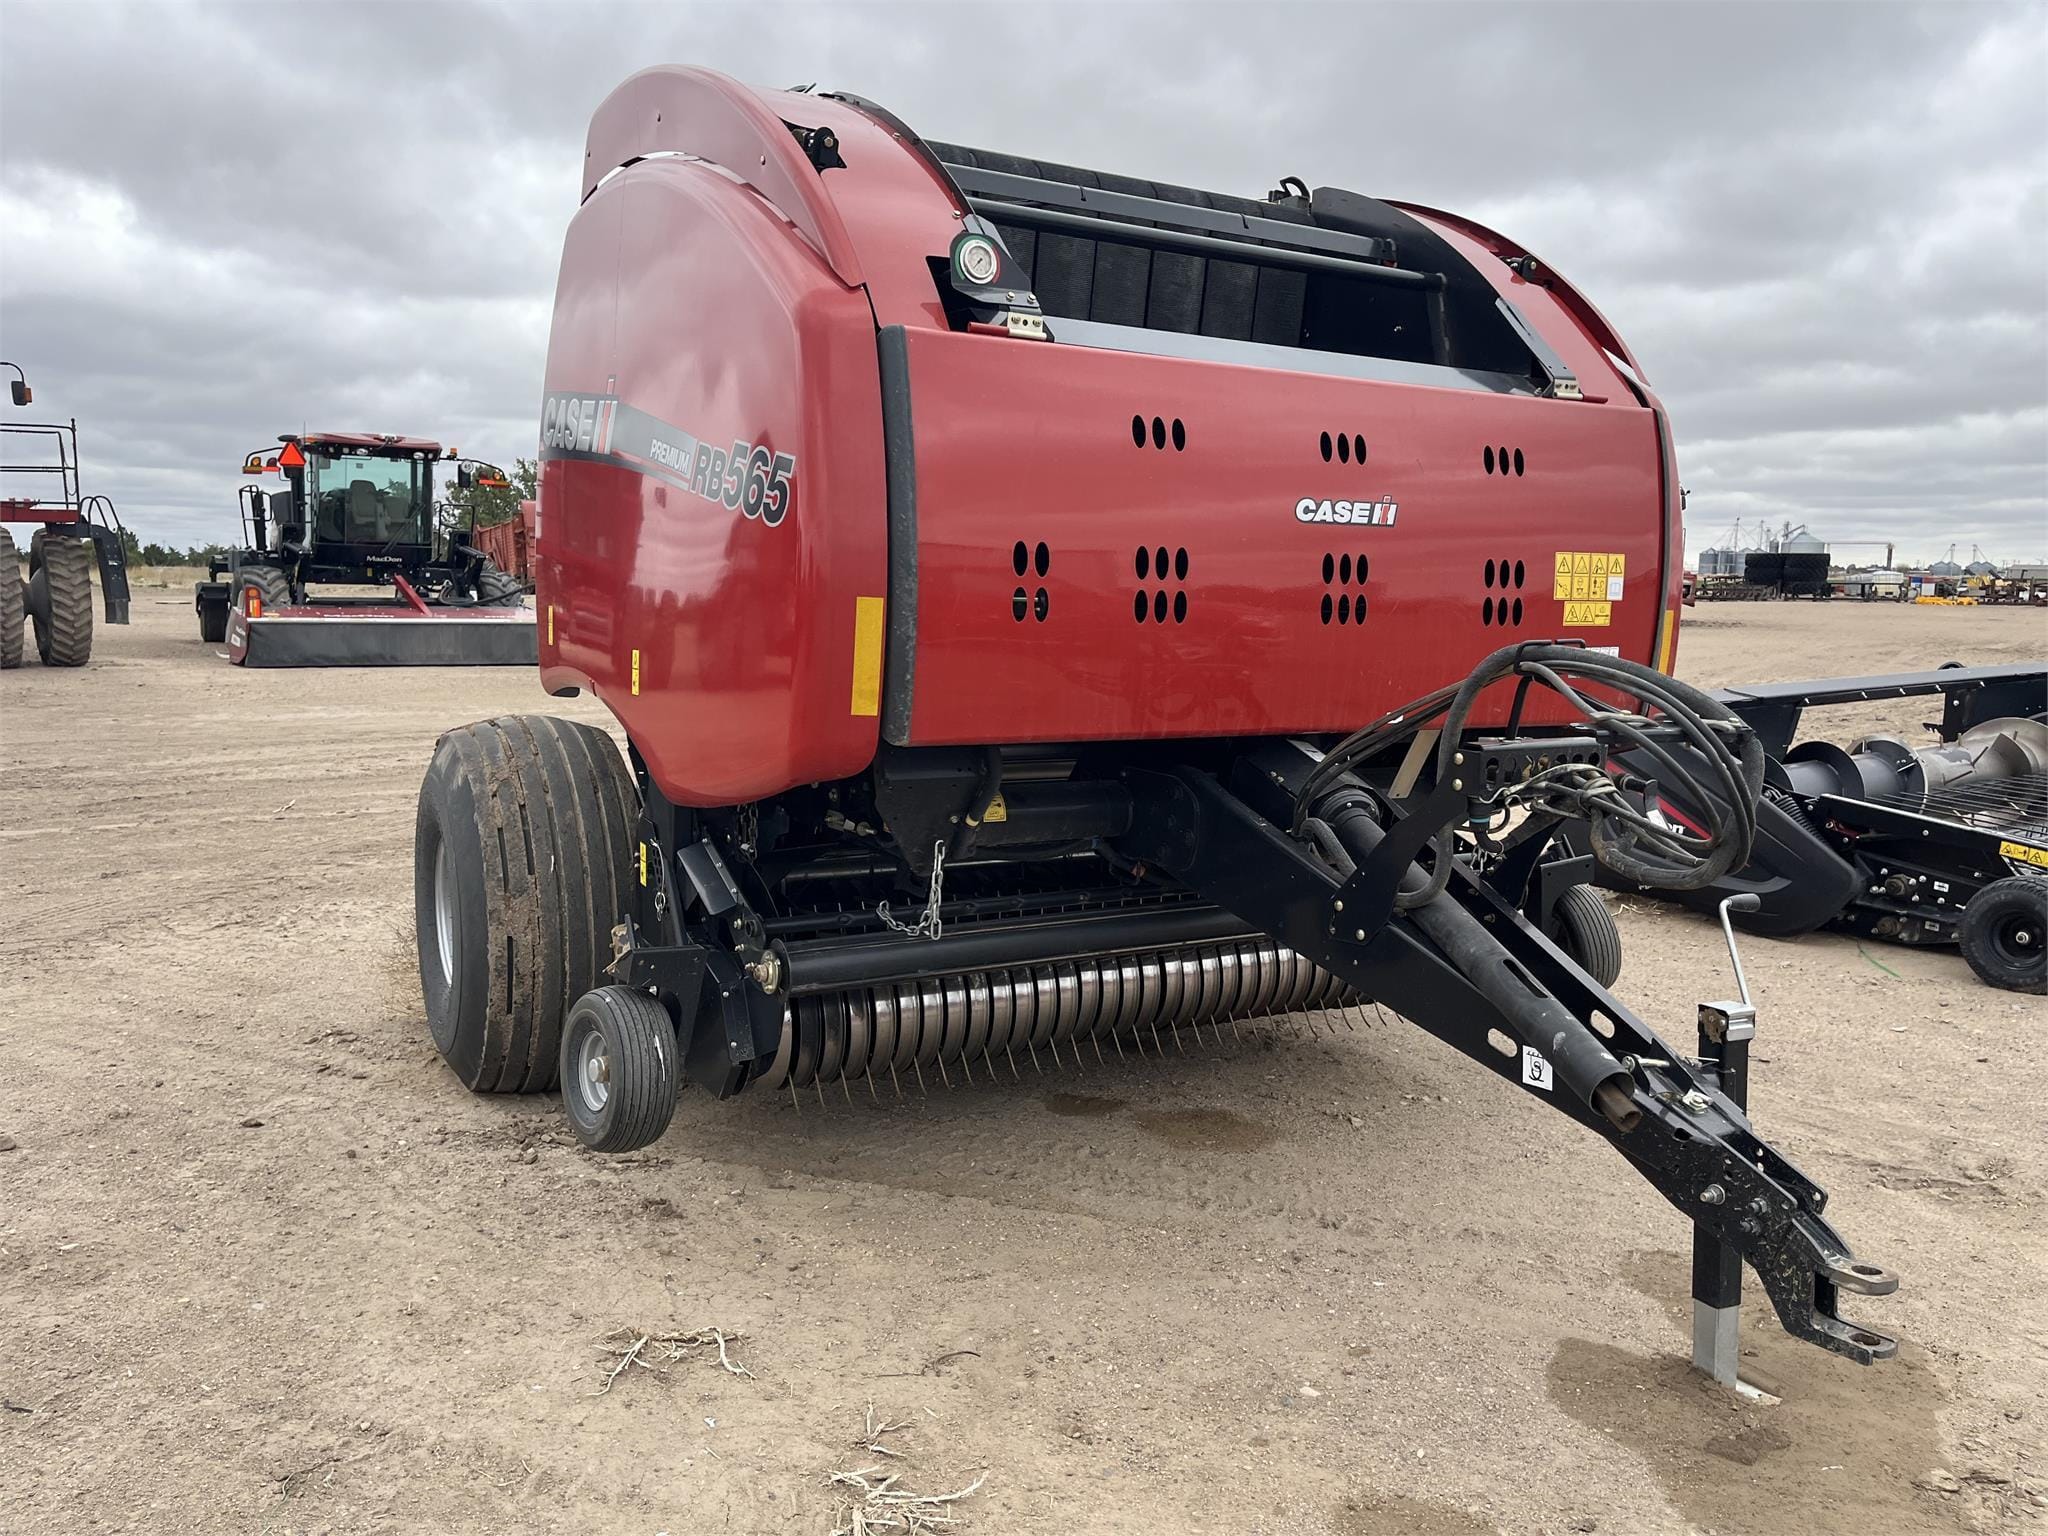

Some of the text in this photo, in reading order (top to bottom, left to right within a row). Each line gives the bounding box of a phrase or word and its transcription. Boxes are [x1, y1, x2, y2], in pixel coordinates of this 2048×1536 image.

[650, 439, 796, 528] PREMIUM RB565
[366, 555, 402, 563] MacDon
